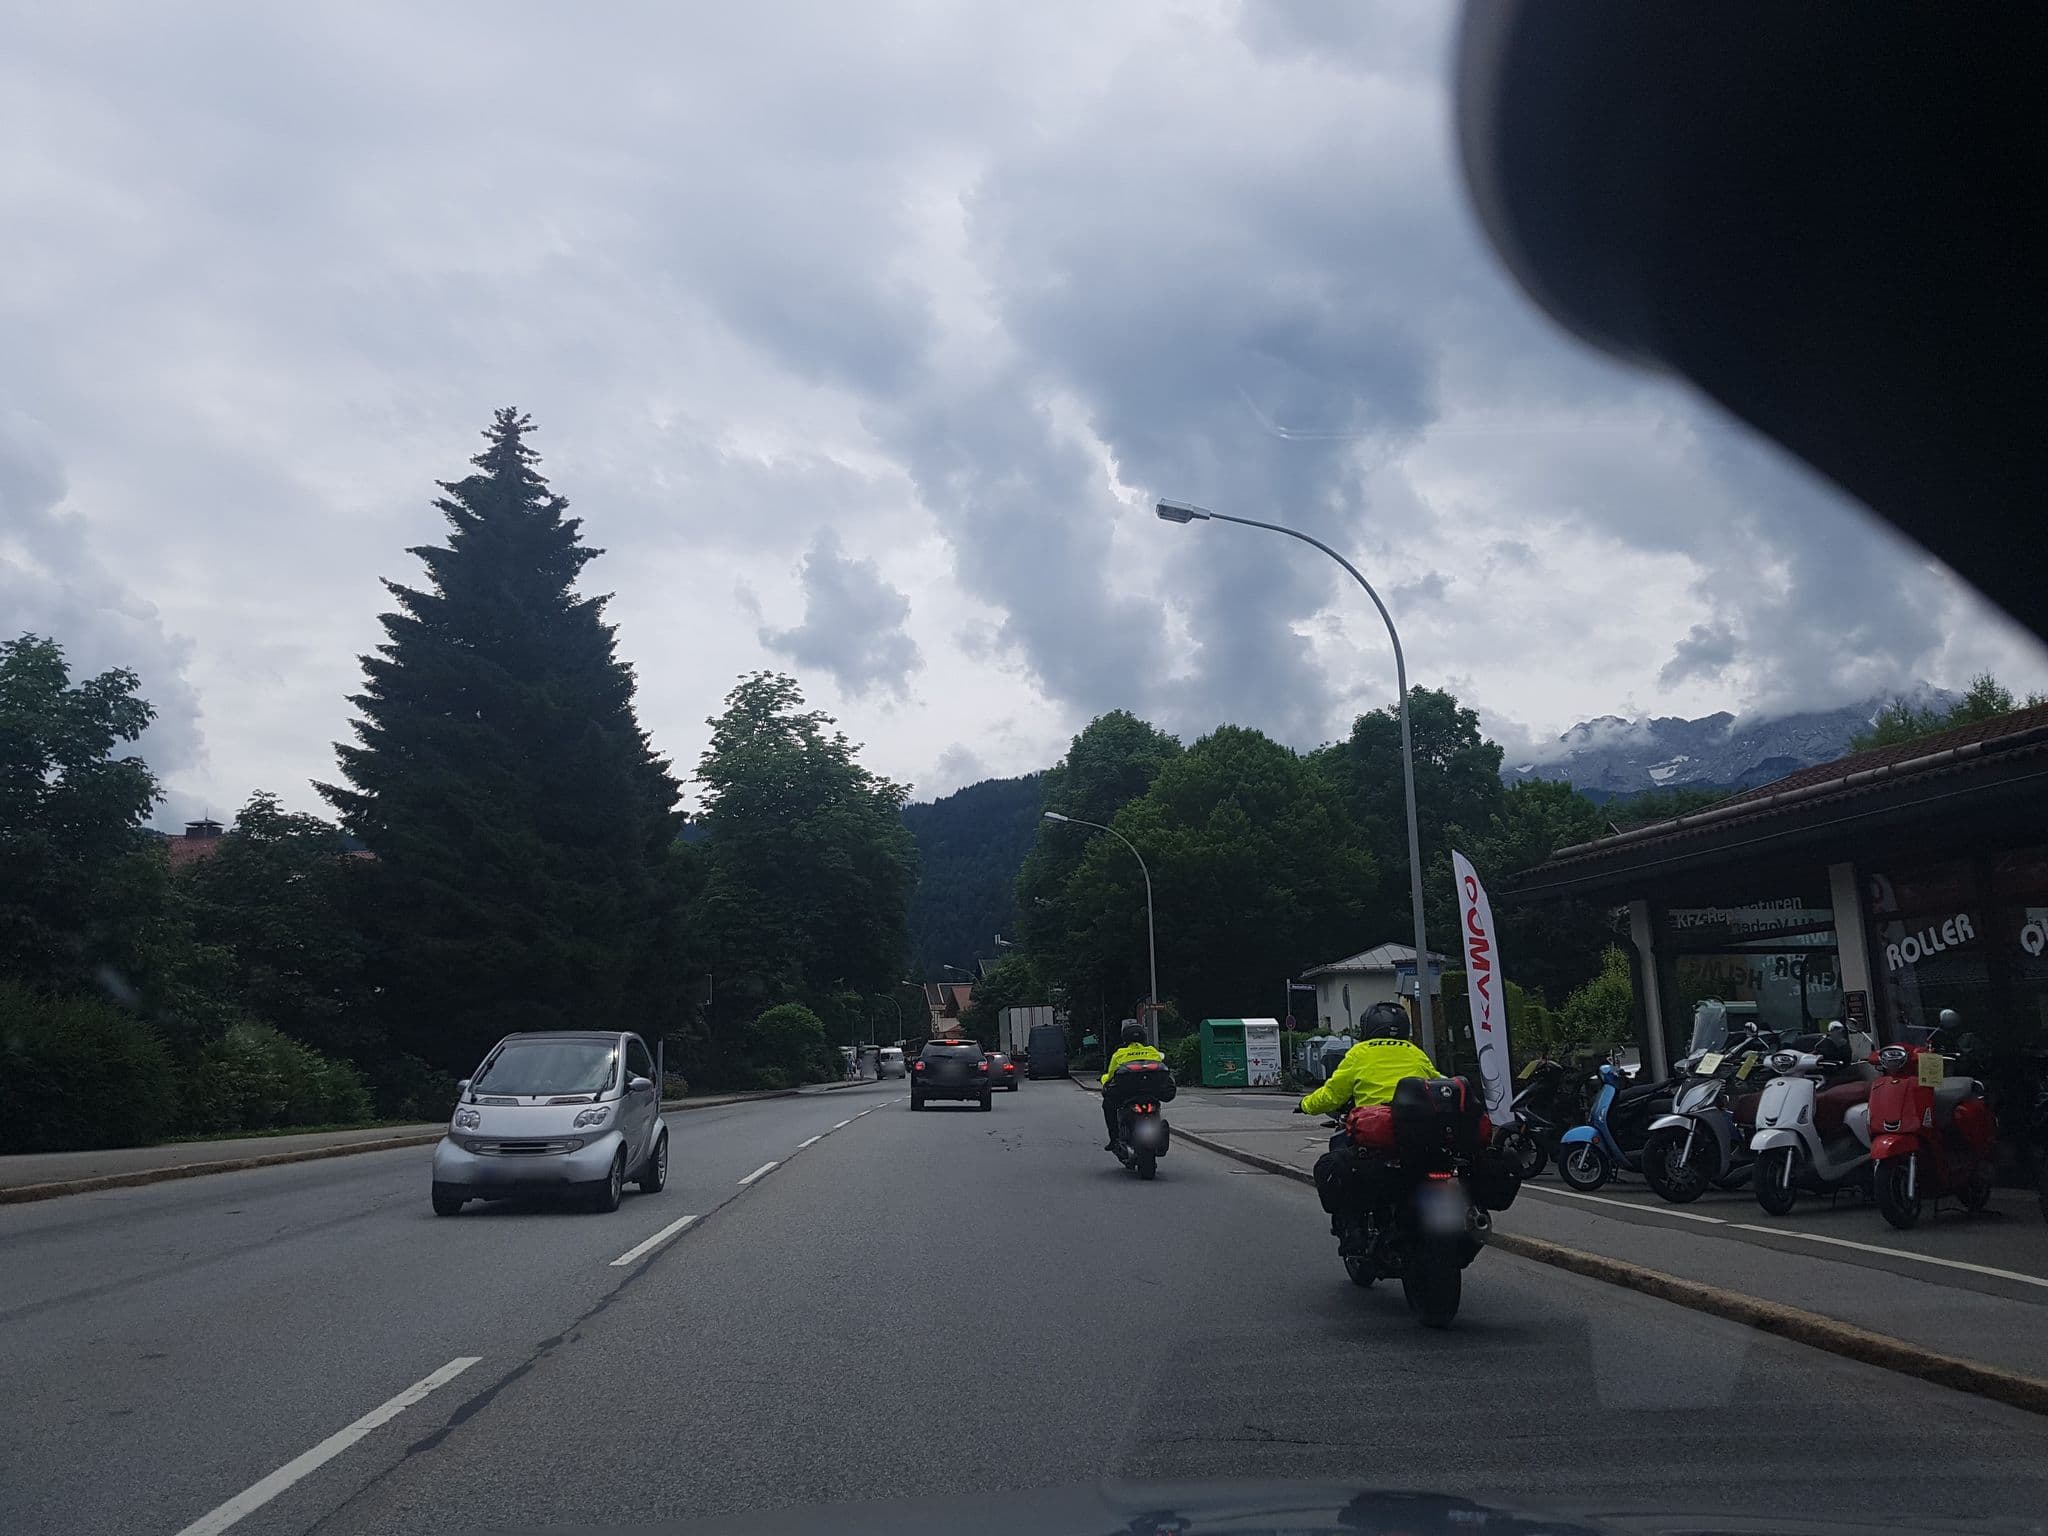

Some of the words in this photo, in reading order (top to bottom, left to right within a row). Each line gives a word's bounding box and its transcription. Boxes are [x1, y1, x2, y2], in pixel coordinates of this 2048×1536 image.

[1677, 896, 1802, 929] KFZ-Repaturen
[1886, 913, 1975, 971] ROLLER
[1368, 1039, 1413, 1048] SCOTT
